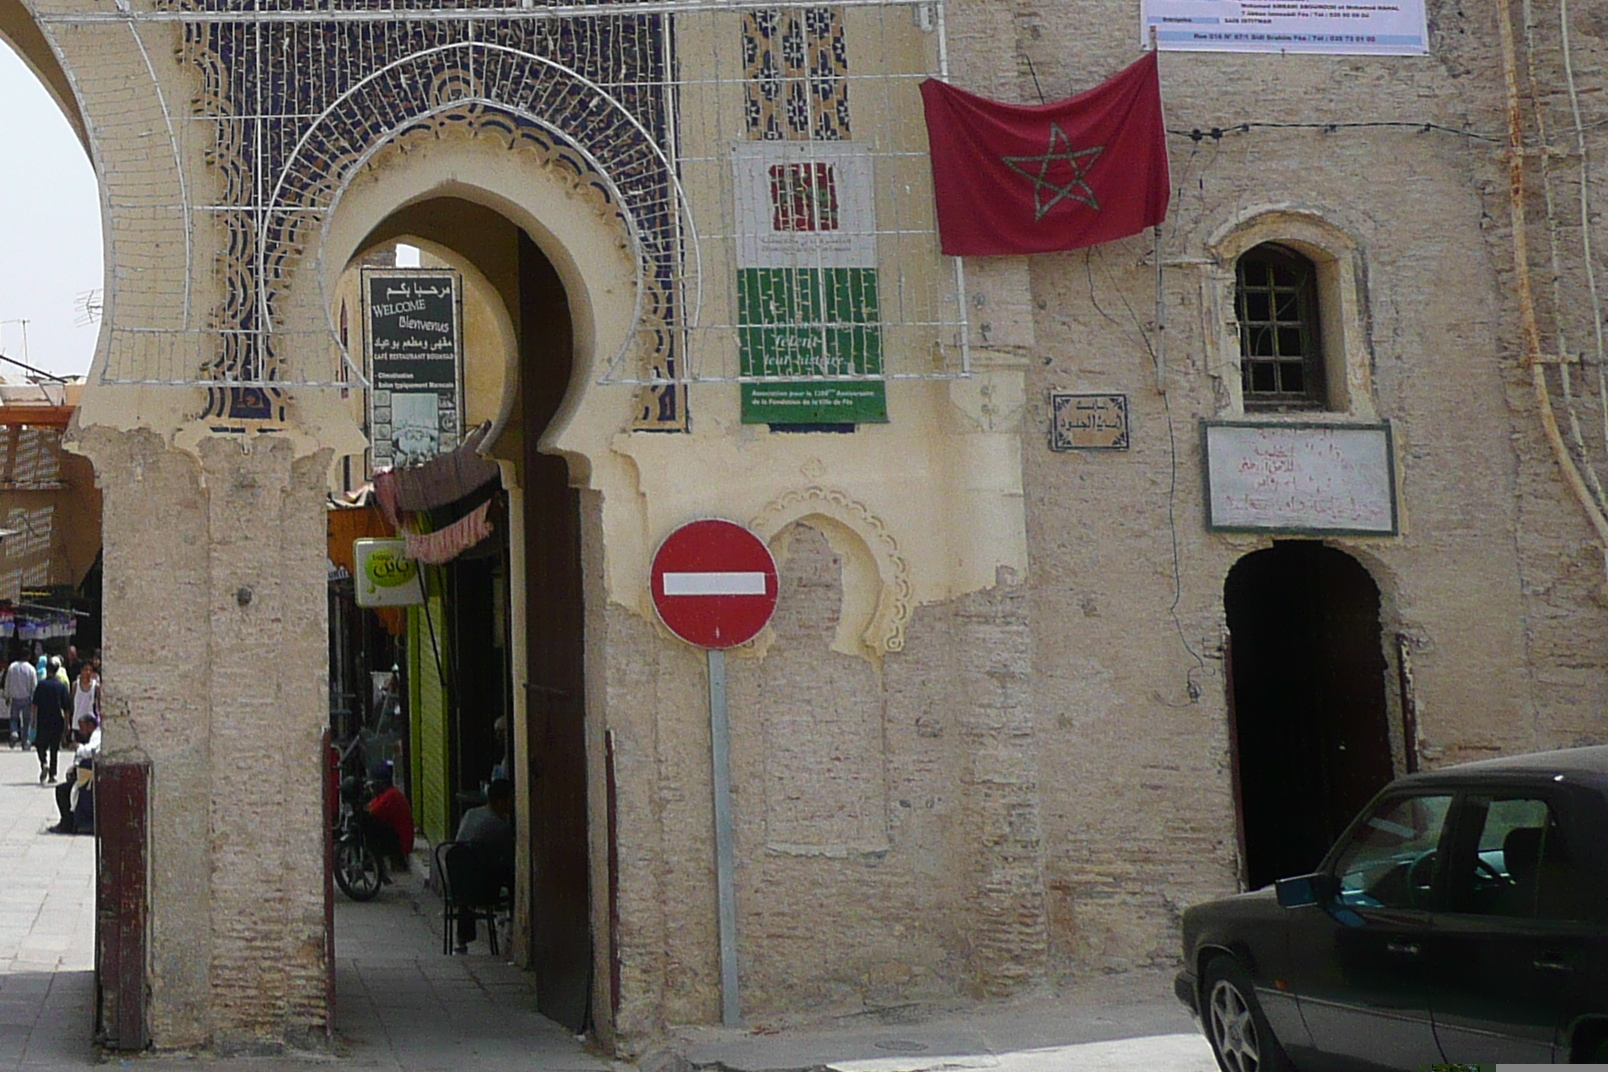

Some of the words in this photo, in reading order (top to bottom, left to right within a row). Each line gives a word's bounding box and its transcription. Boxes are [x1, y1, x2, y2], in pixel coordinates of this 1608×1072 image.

[386, 282, 410, 301] بكم
[413, 281, 451, 298] مرحبا
[372, 299, 427, 318] WELCOME
